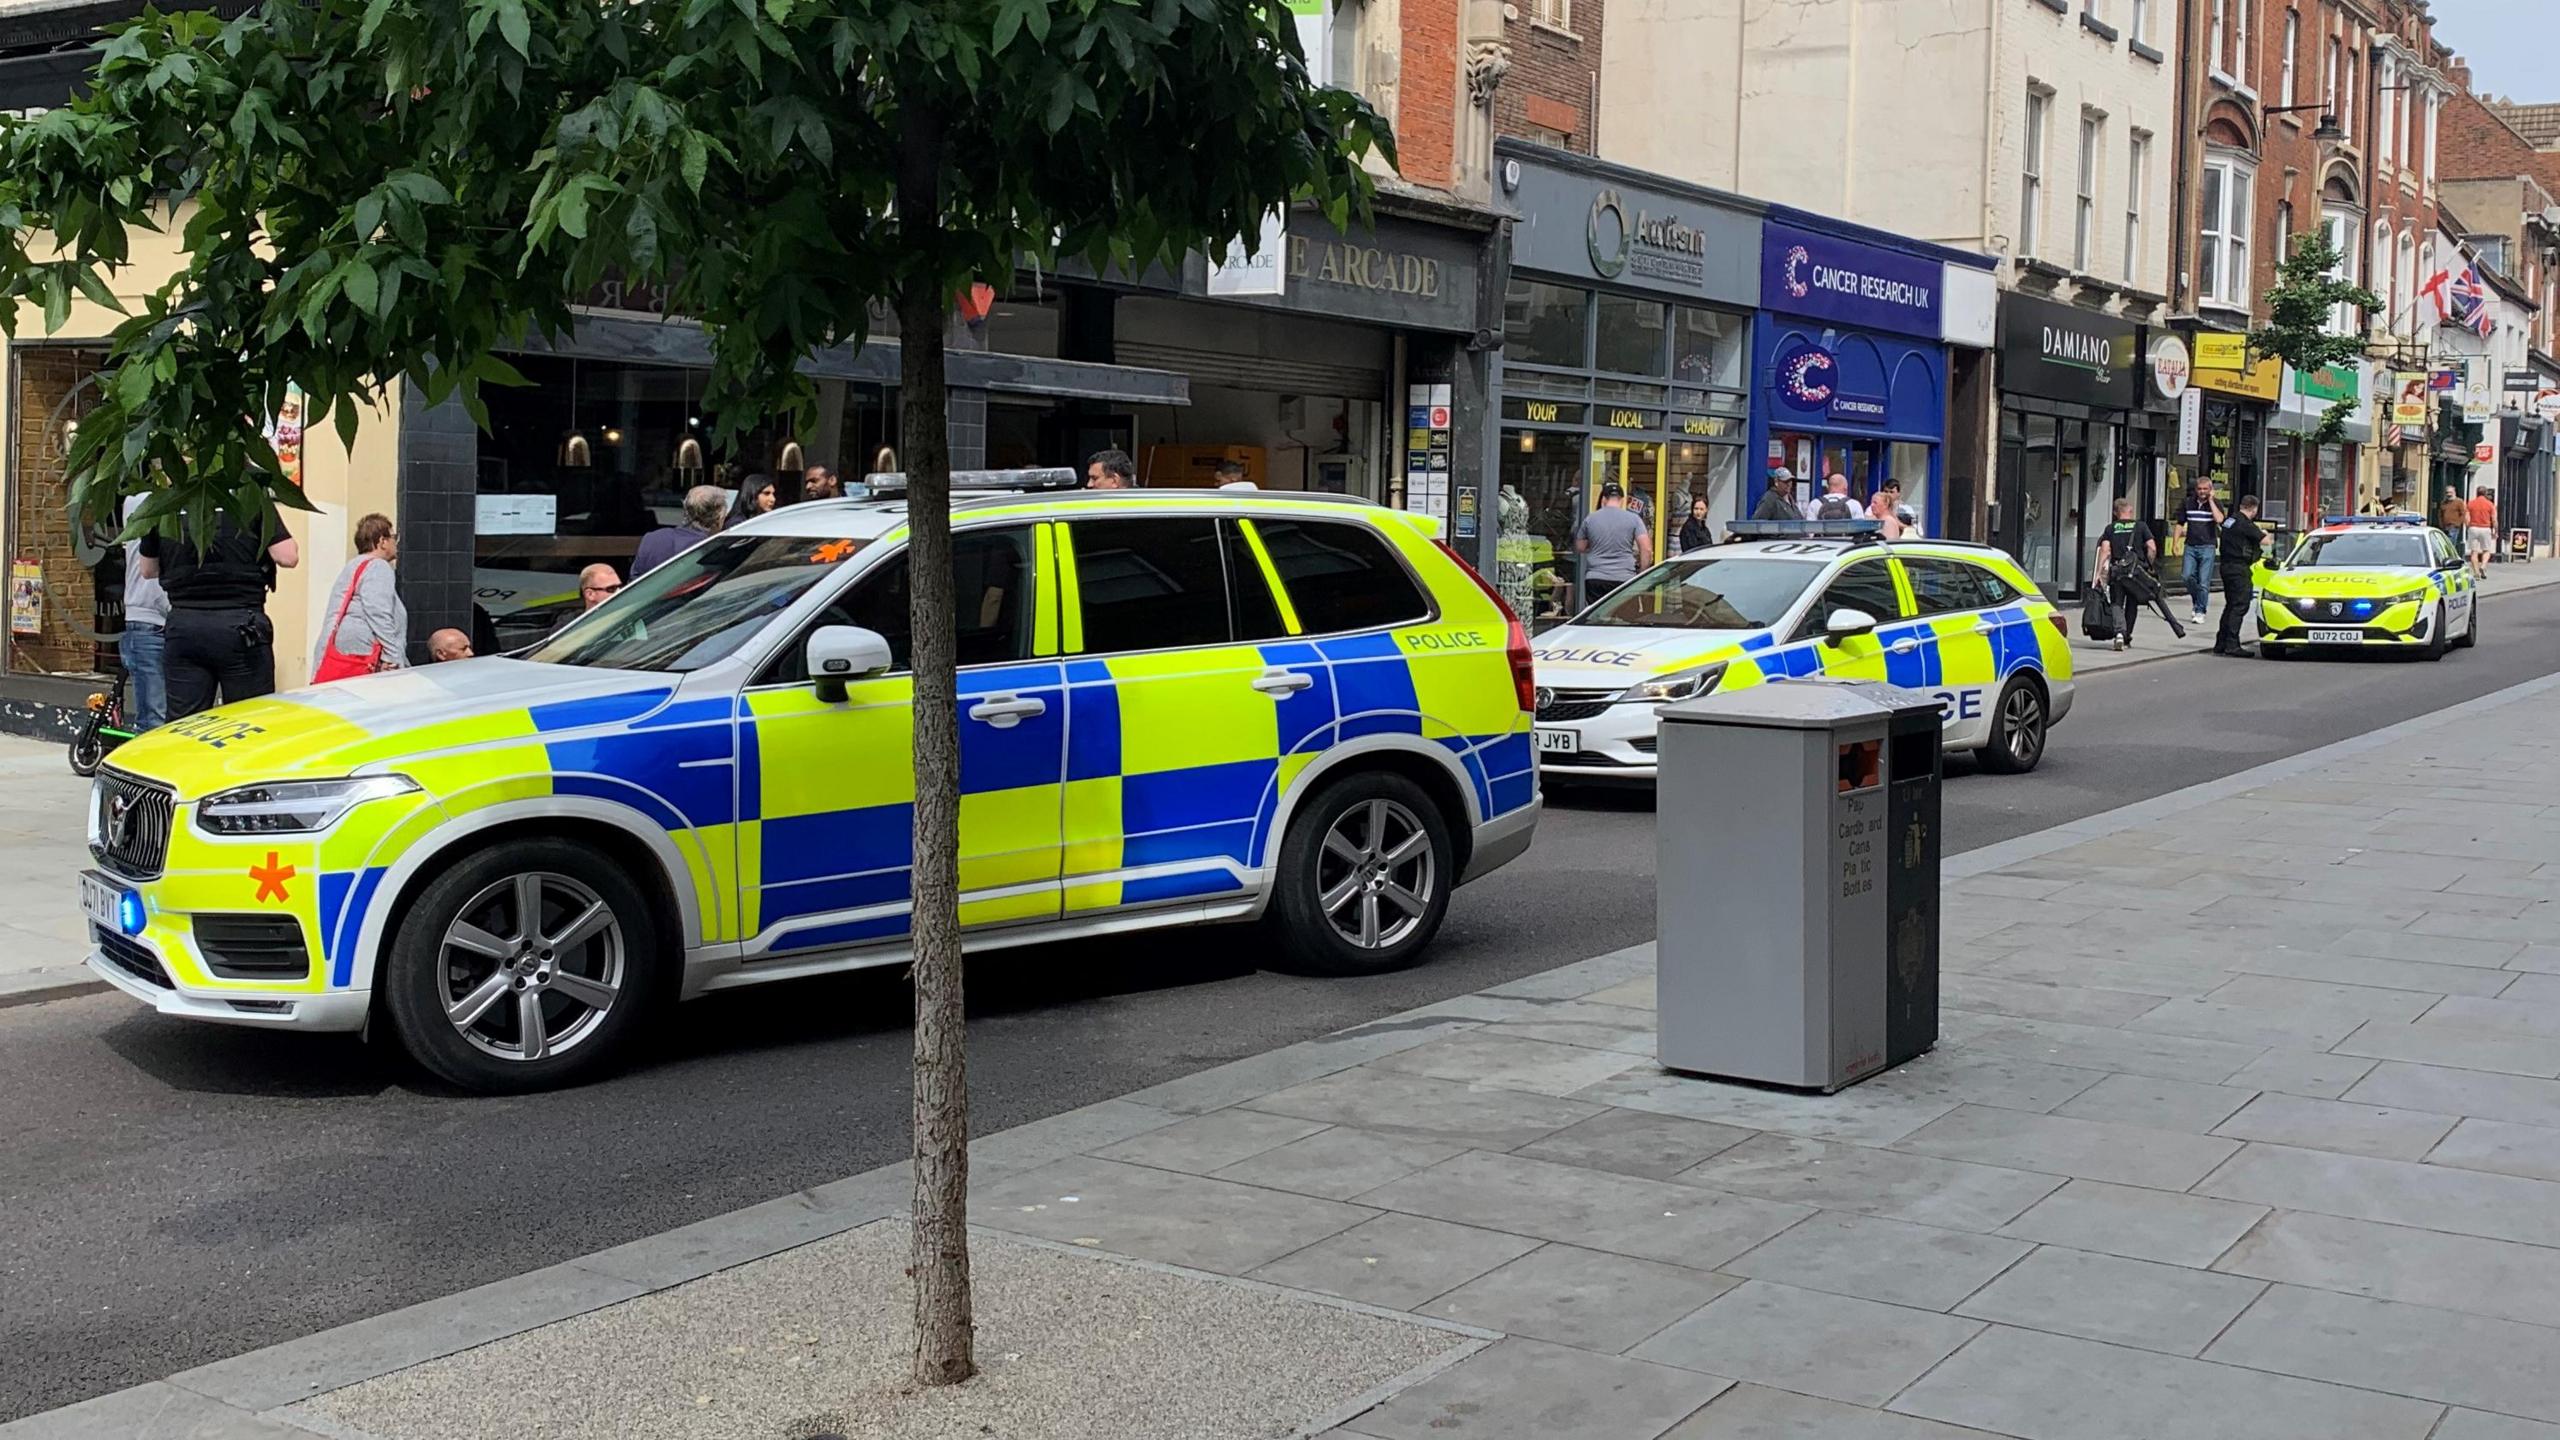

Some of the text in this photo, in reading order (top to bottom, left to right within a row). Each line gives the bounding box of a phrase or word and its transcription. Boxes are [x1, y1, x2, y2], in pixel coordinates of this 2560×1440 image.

[1634, 209, 1706, 257] Autism
[1318, 241, 1438, 297] ARCADE
[1812, 265, 1929, 308] CANCER RESEARCH UK
[2043, 326, 2110, 366] DAMIANO
[1840, 401, 1857, 411] CANCER
[1526, 401, 1726, 437] YOUR LOCAL CHARITY
[1629, 497, 1644, 511] PEN
[2302, 574, 2378, 585] POLICE
[2449, 597, 2468, 611] POLICE
[1405, 631, 1487, 650] POLICE
[2312, 631, 2337, 641] OU72
[1533, 649, 1642, 666] POLICE
[168, 714, 267, 749] POLICE
[1544, 734, 1570, 749] JYB
[1838, 815, 1882, 839] Cardbard
[1849, 841, 1871, 857] Cans
[1843, 858, 1872, 878] Platic
[1843, 878, 1873, 898] Bottes
